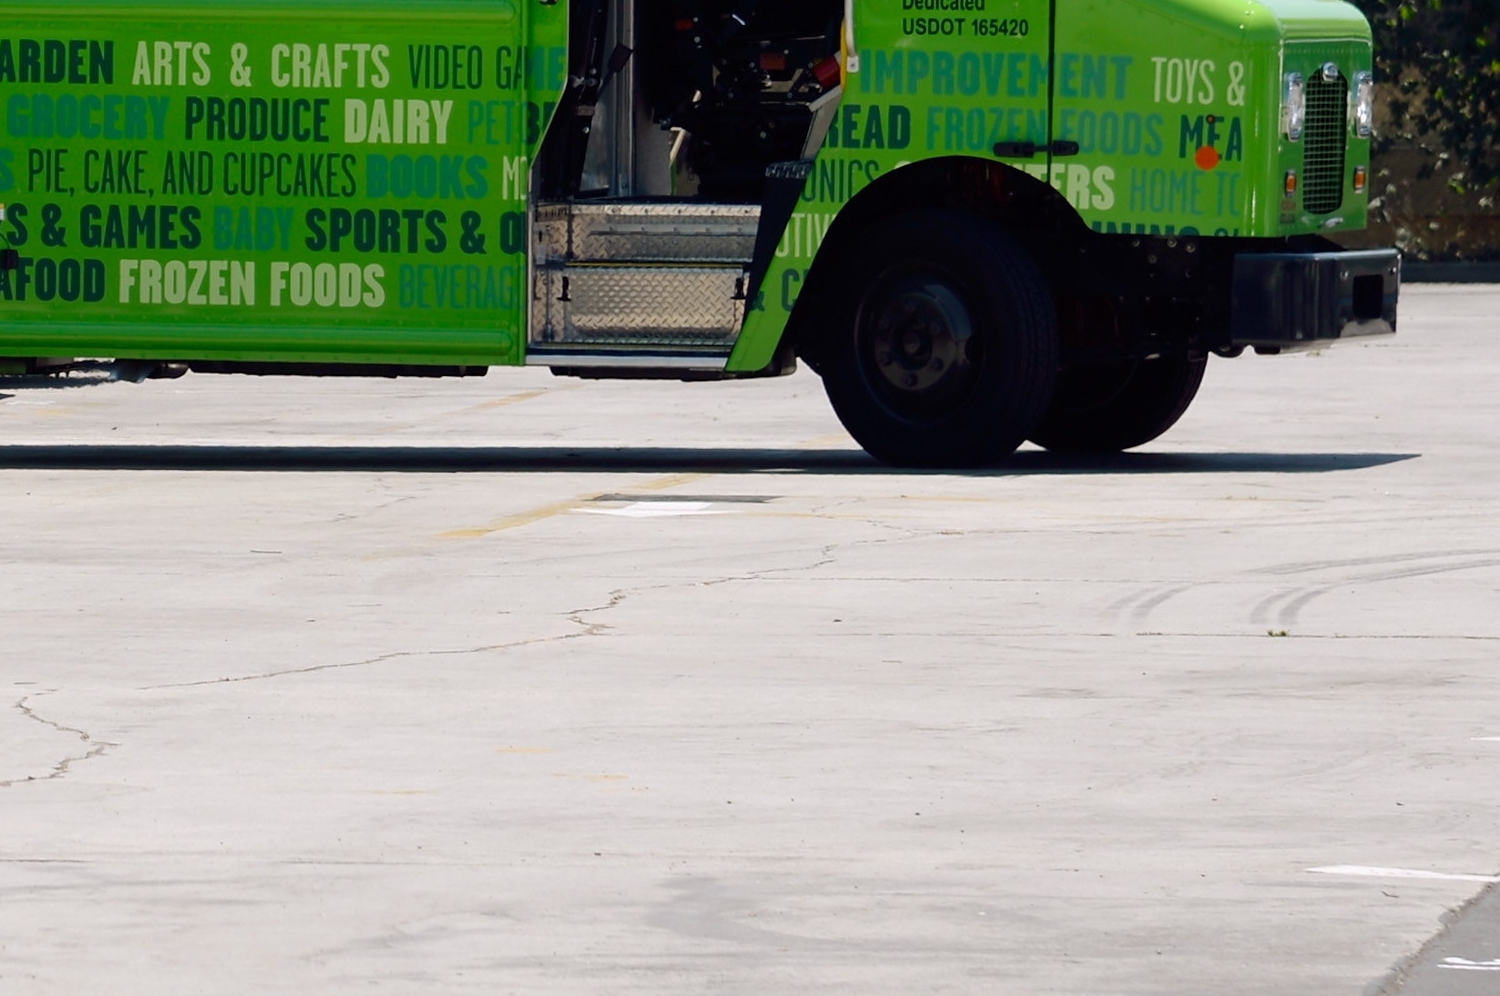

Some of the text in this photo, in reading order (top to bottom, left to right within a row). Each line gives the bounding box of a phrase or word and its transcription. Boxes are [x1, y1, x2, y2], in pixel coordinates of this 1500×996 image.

[903, 18, 1028, 36] USDOT 165420
[132, 41, 211, 86] ARTS
[230, 43, 252, 87] &
[271, 43, 390, 88] CRAFTS
[409, 45, 482, 89] VIDEO
[860, 49, 1245, 106] IMPROVEMENT TOYS &
[7, 93, 171, 140] GROCERY
[185, 96, 330, 142] PRODUCE
[344, 99, 453, 144] DAIRY
[926, 106, 1047, 153] FROZEN
[1060, 108, 1164, 157] FOODS
[28, 149, 357, 197] PIE, CAKE, AND CUPCAKES
[366, 155, 488, 200] BOOKS
[1130, 167, 1203, 215] HOME
[42, 204, 66, 248] &
[80, 204, 202, 250] GAMES
[214, 207, 295, 252] BABY
[305, 208, 447, 254] SPORTS
[460, 211, 487, 255] &
[119, 259, 386, 307] FROZEN FOODS
